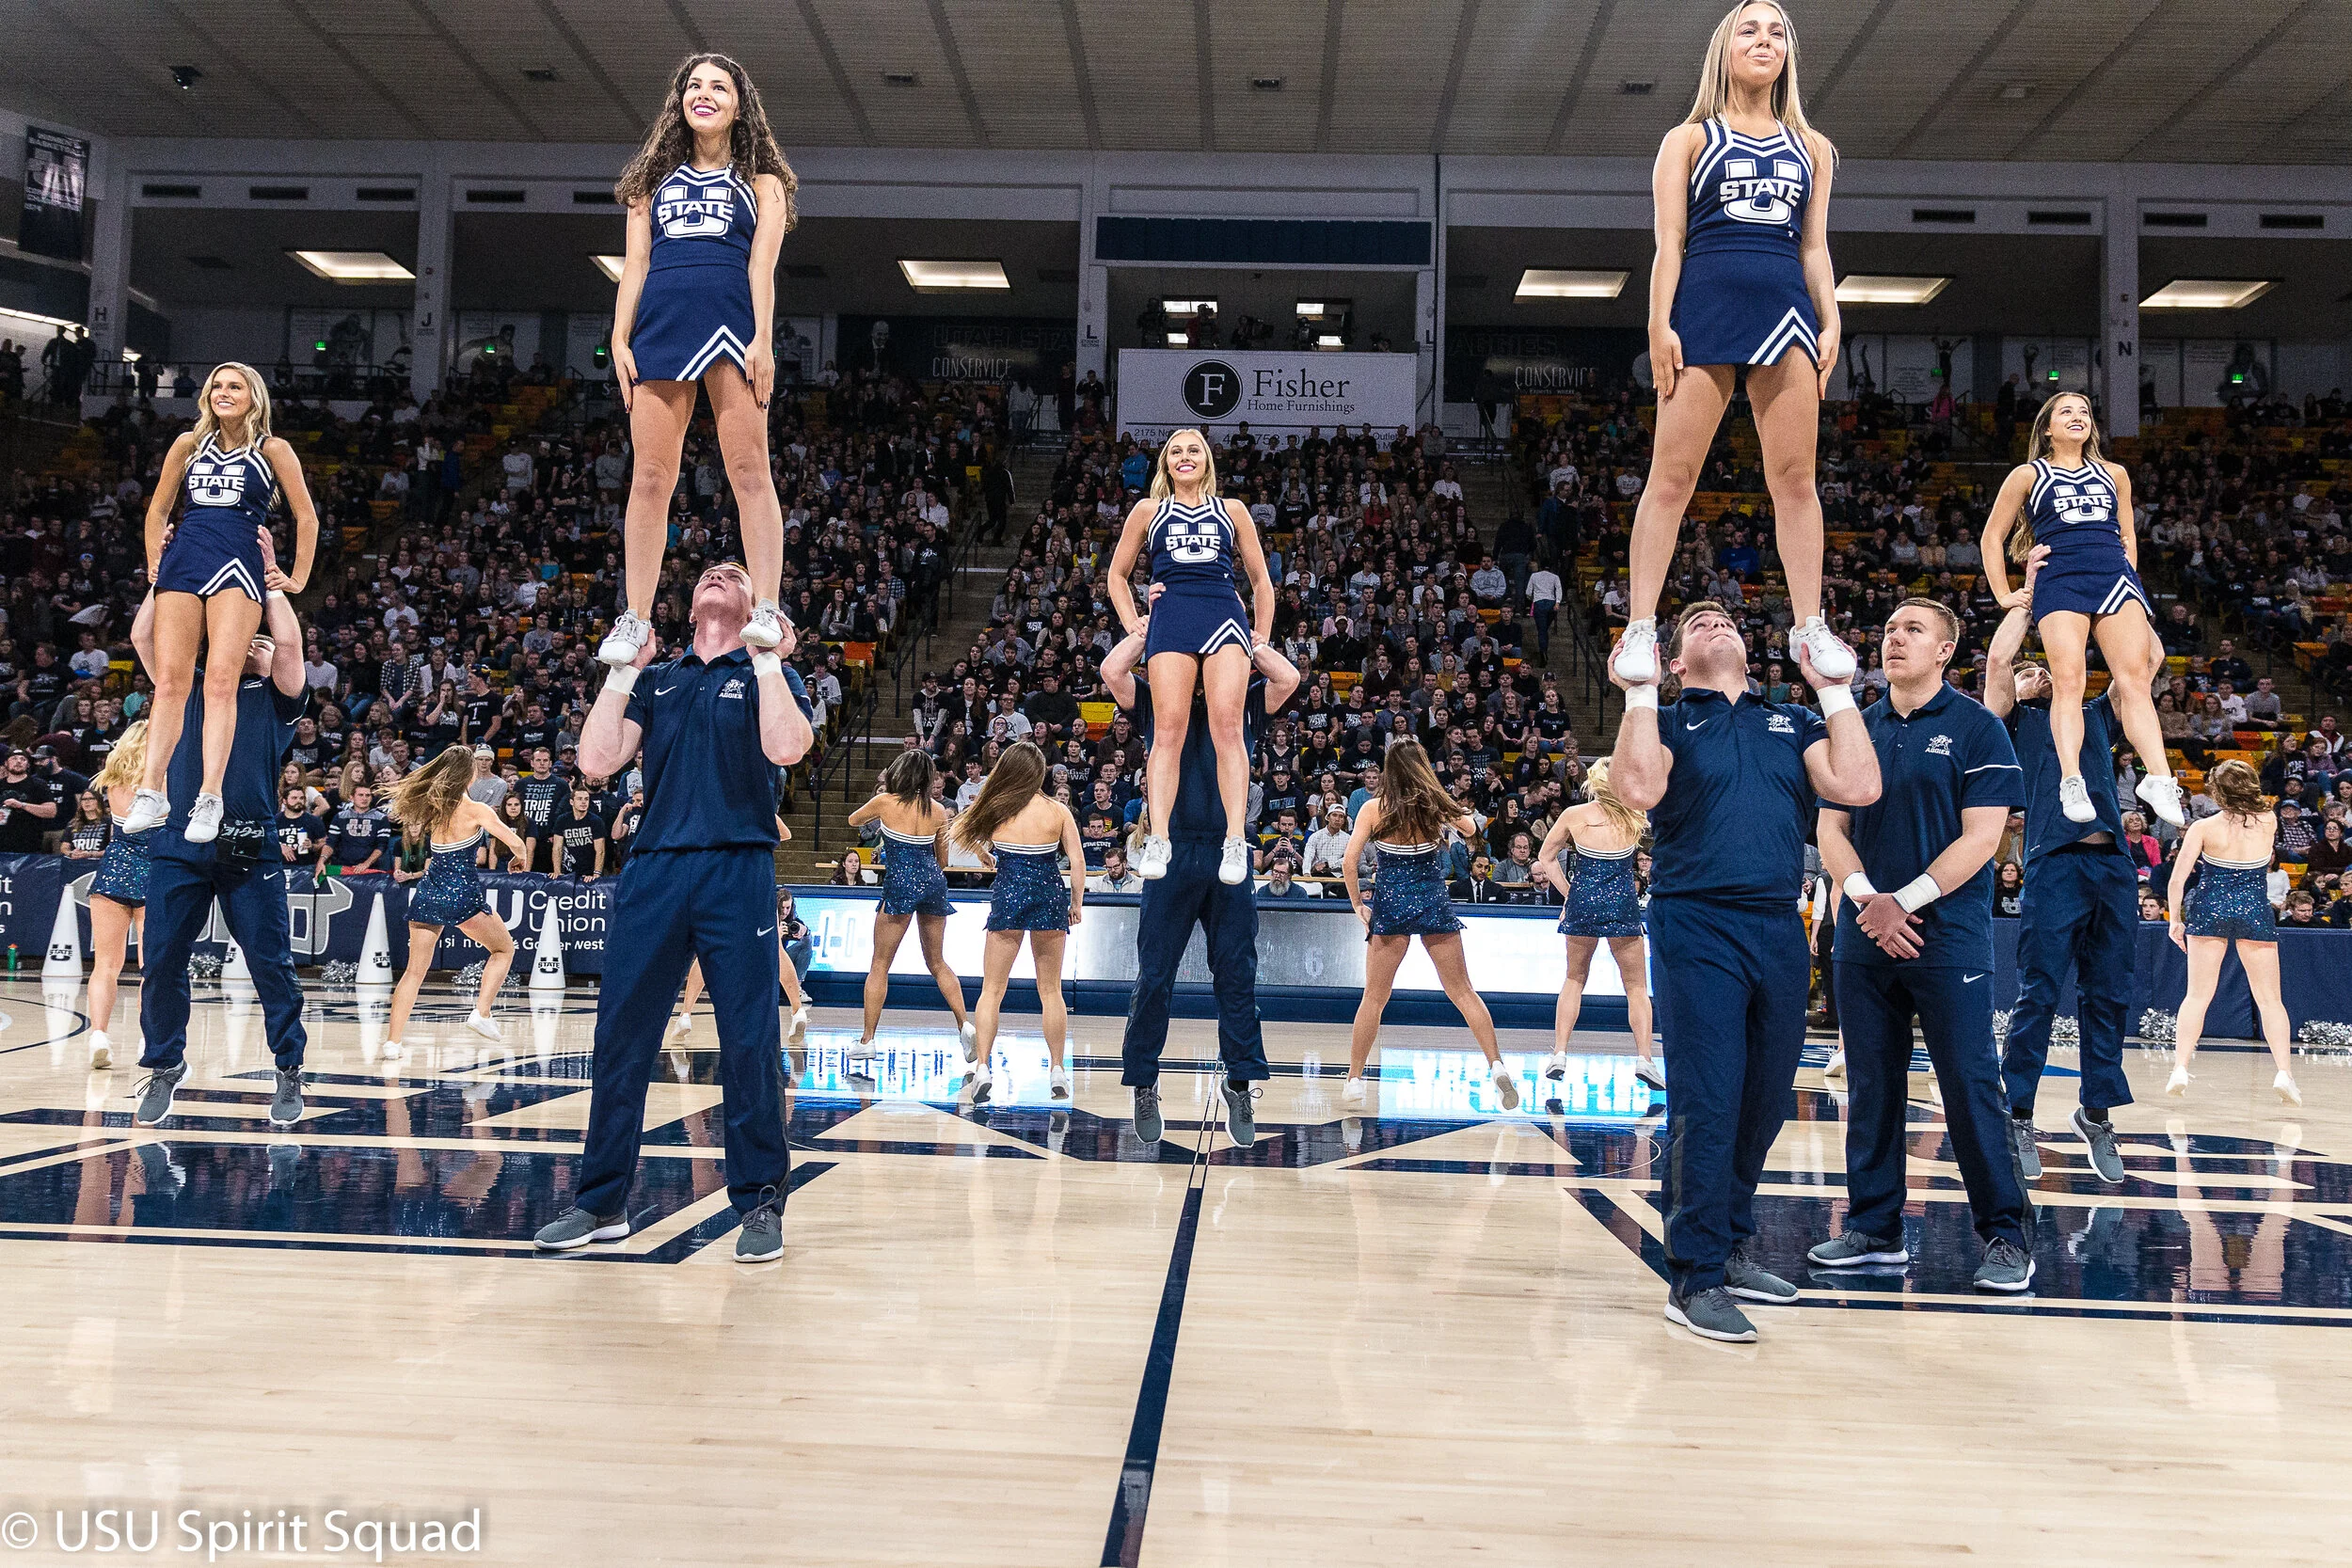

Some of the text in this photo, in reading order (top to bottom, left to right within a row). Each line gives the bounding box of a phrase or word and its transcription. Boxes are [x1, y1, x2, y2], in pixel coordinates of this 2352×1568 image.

[1720, 178, 1804, 207] STATE
[657, 200, 734, 225] STATE
[421, 312, 432, 327] J
[1087, 325, 1098, 340] L
[2118, 341, 2132, 356] N
[932, 356, 1014, 380] CONSERVICE
[1252, 368, 1350, 398] Fisher
[1248, 399, 1355, 414] Home Furnishings
[188, 475, 246, 492] STATE
[2053, 495, 2113, 514] STATE
[1165, 534, 1221, 551] STATE
[524, 799, 553, 811] TRUE
[278, 828, 298, 836] UTA
[72, 838, 103, 850] TRUE
[529, 890, 607, 911] Credit
[49, 948, 73, 957] STATE
